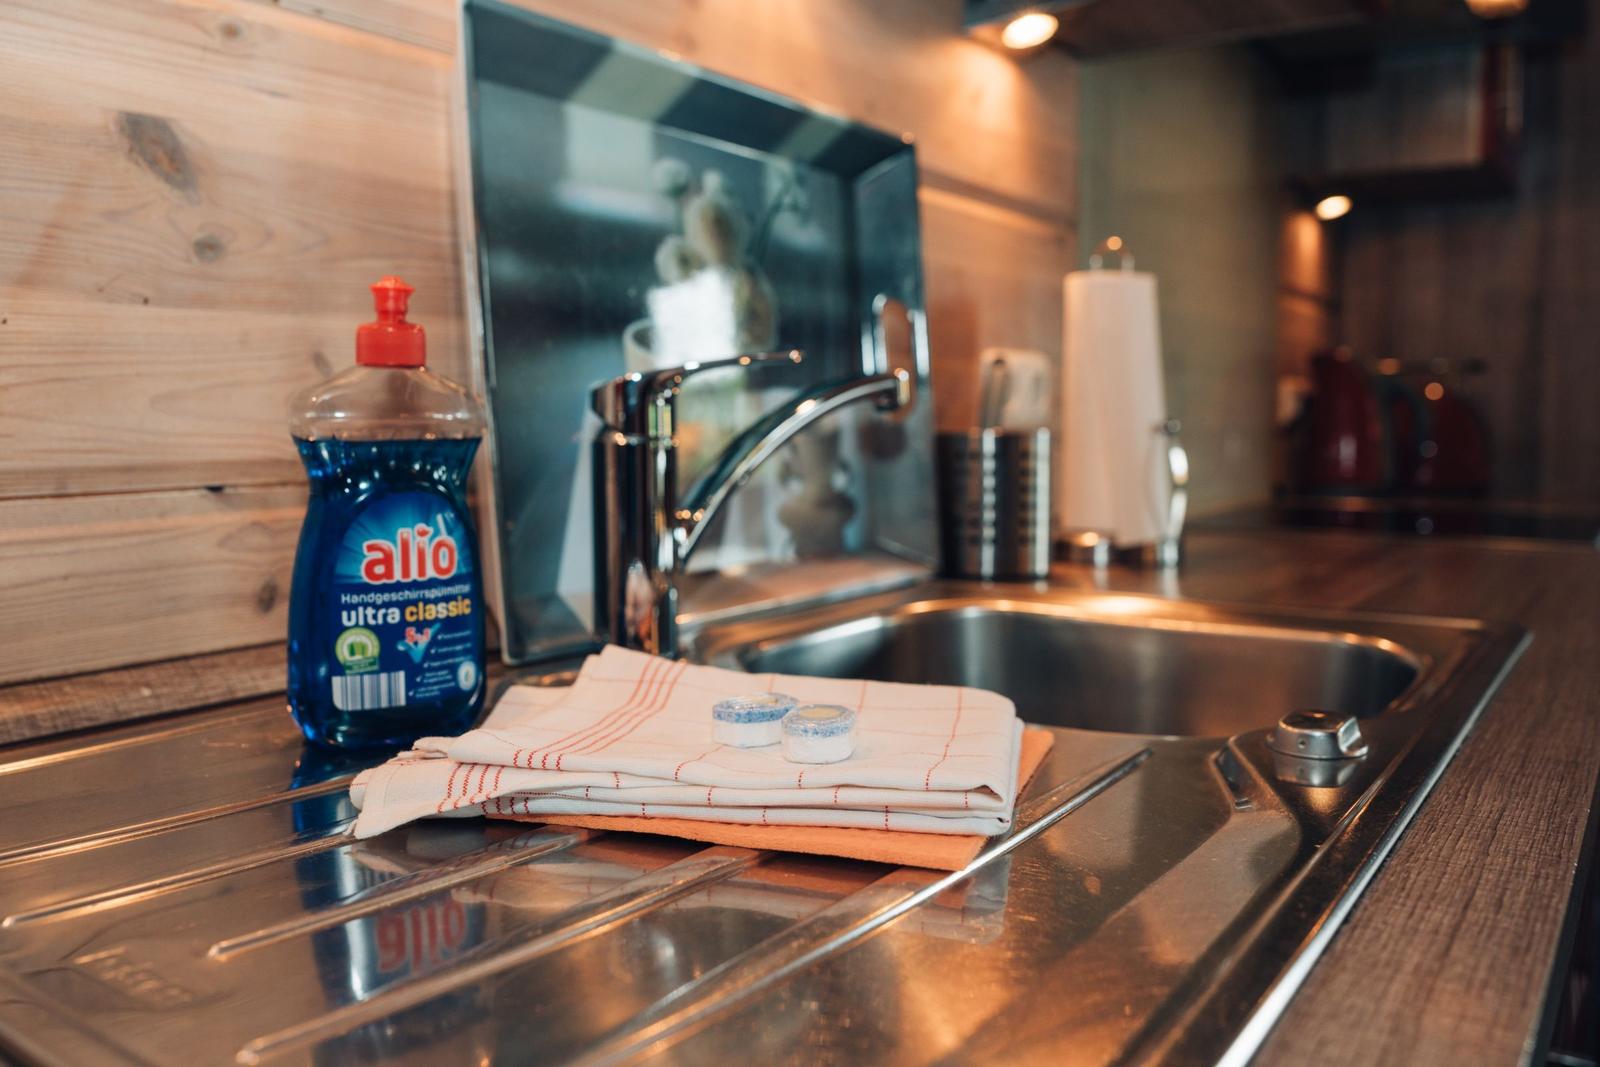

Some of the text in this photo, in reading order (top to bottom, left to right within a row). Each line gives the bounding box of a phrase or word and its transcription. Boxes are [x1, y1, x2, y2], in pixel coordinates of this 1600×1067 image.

[361, 523, 457, 584] alio
[341, 596, 471, 626] ultra classic
